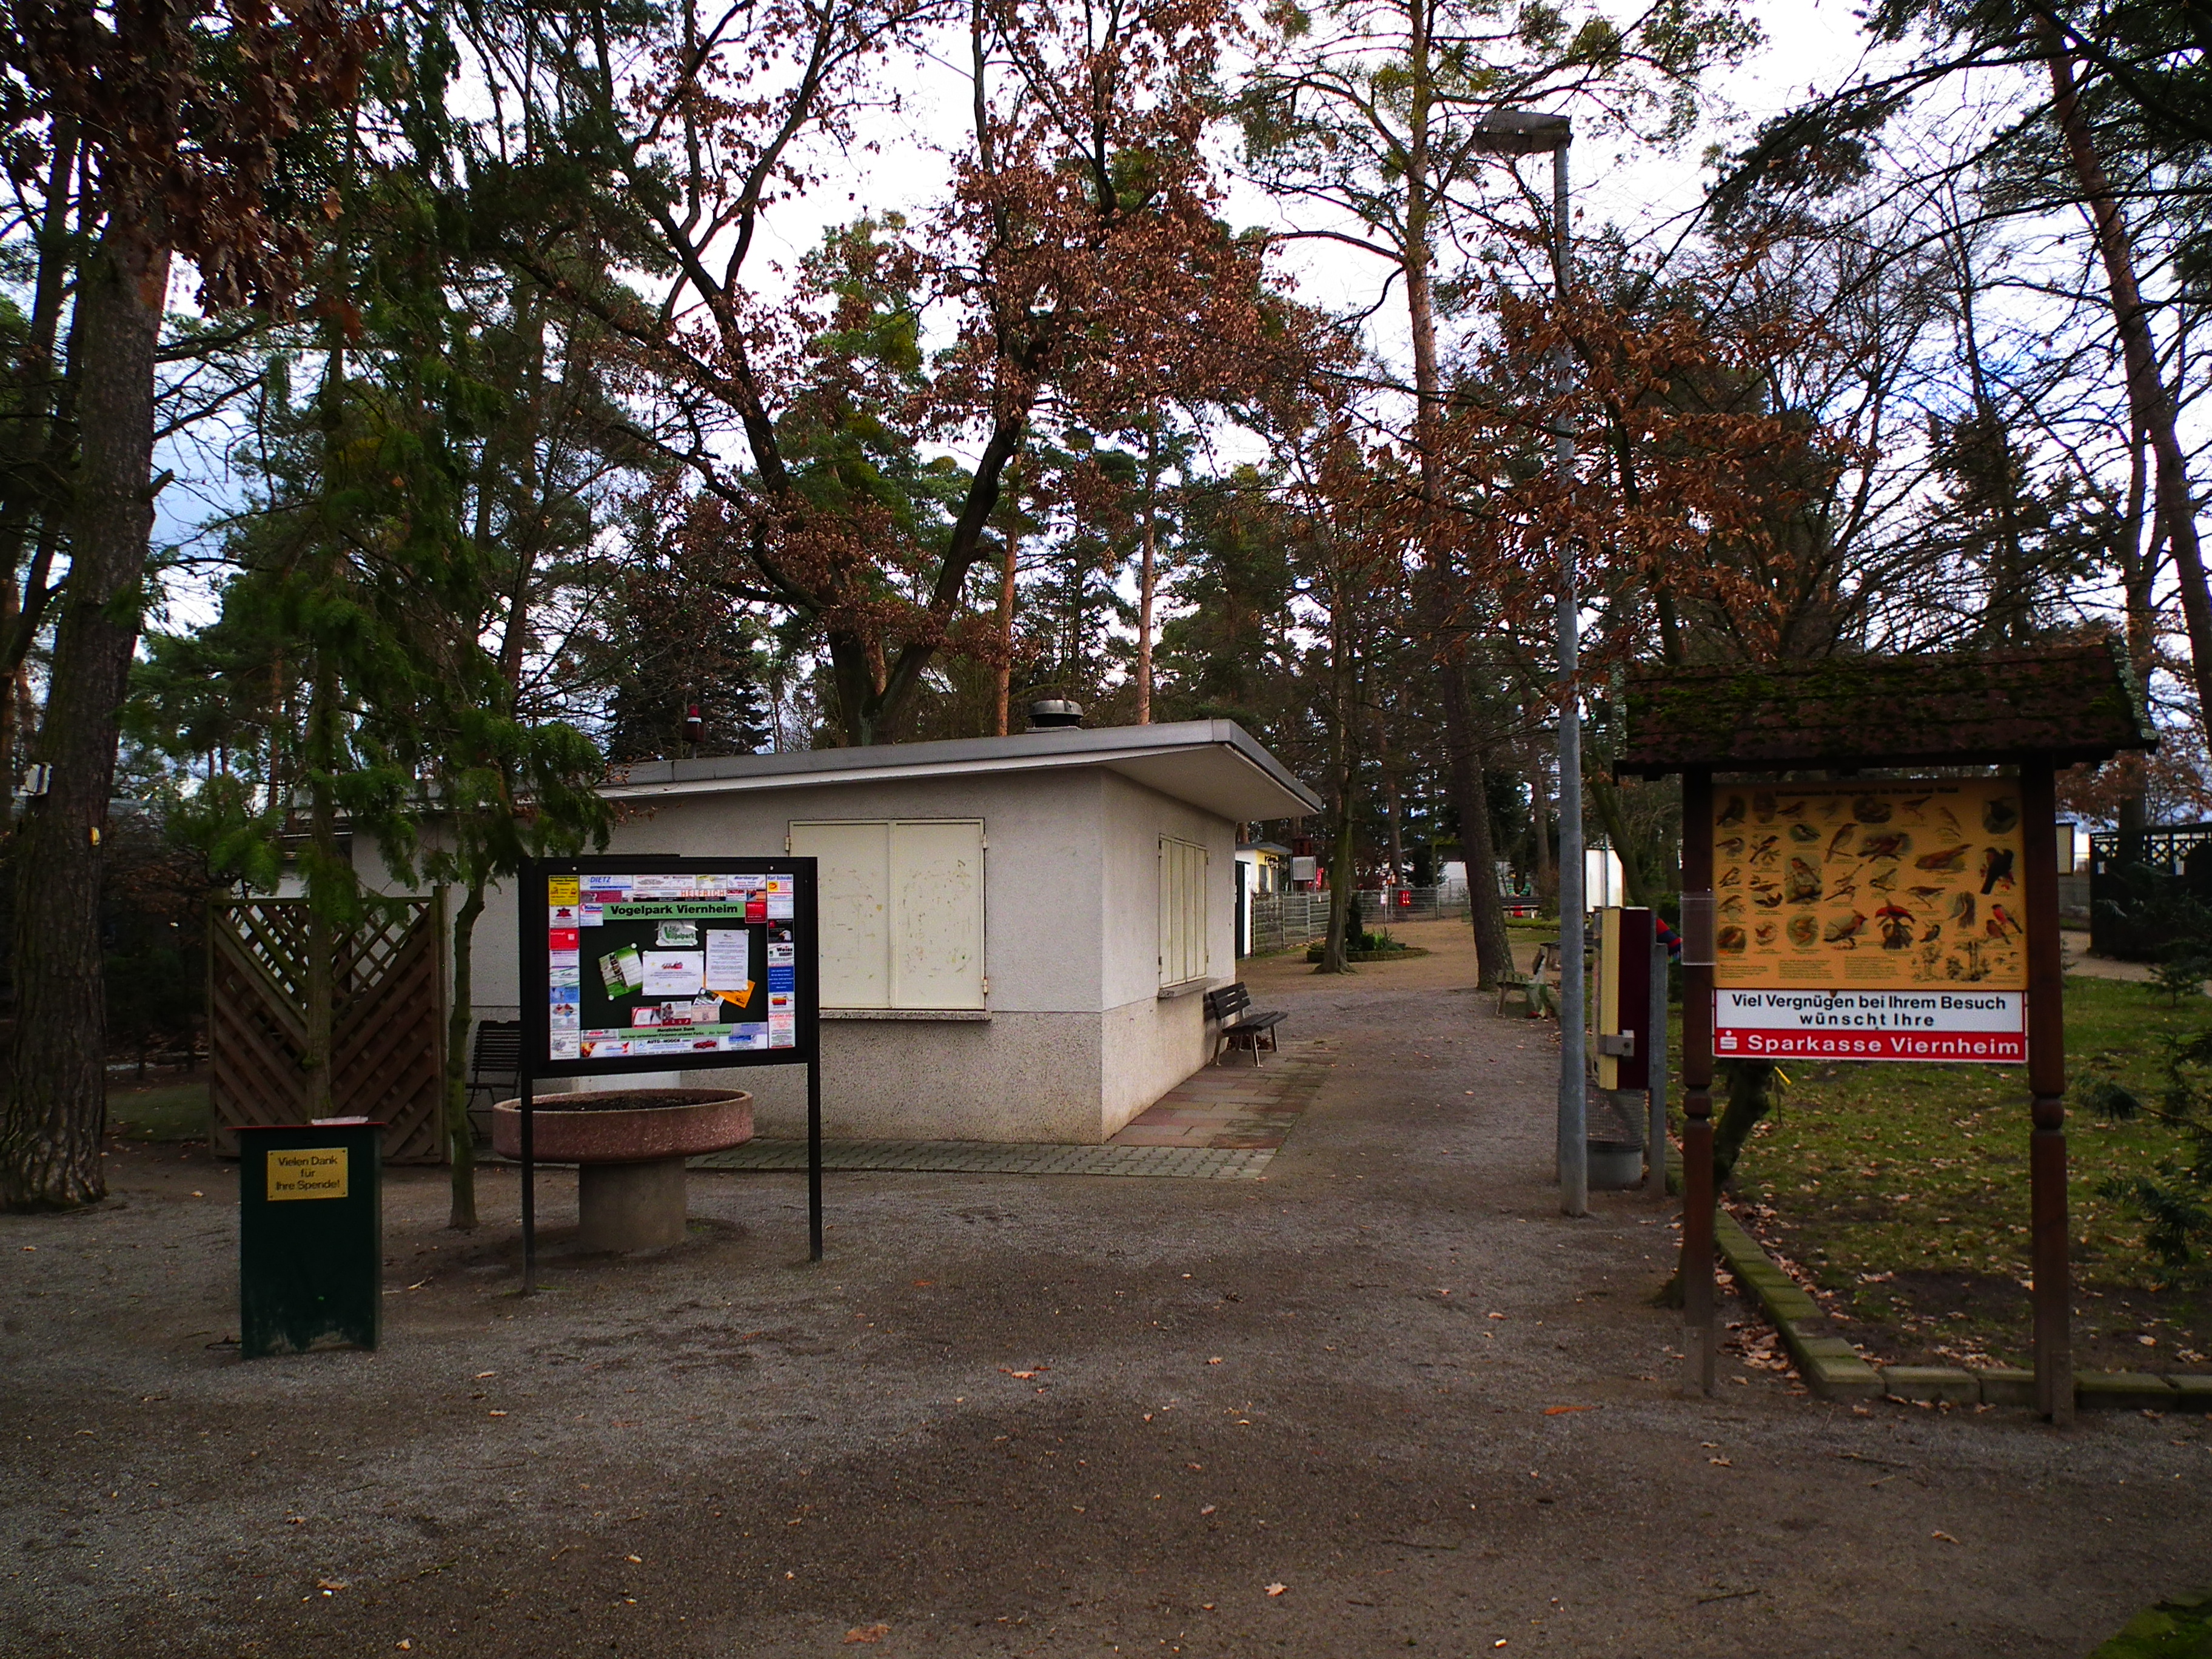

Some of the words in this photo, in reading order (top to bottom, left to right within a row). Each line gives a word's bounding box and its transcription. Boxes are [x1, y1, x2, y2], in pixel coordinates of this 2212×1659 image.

[611, 905, 673, 916] Vogelpark
[677, 904, 738, 914] Viernheim
[1732, 995, 1761, 1007] Viel
[1766, 994, 1854, 1011] Vergnügen
[1859, 995, 1885, 1009] bei
[1889, 996, 1936, 1009] Ihrem
[1942, 996, 2006, 1010] Besuch
[1800, 1013, 1886, 1026] wünscht
[1894, 1014, 1934, 1026] Ihre
[1748, 1035, 1882, 1053] Sparkasse
[1891, 1037, 2020, 1055] Viernheim
[278, 1156, 308, 1166] Vielen
[310, 1155, 337, 1165] Dank
[300, 1168, 316, 1178] für
[276, 1181, 295, 1190] Ihre
[298, 1179, 340, 1191] Spende!
